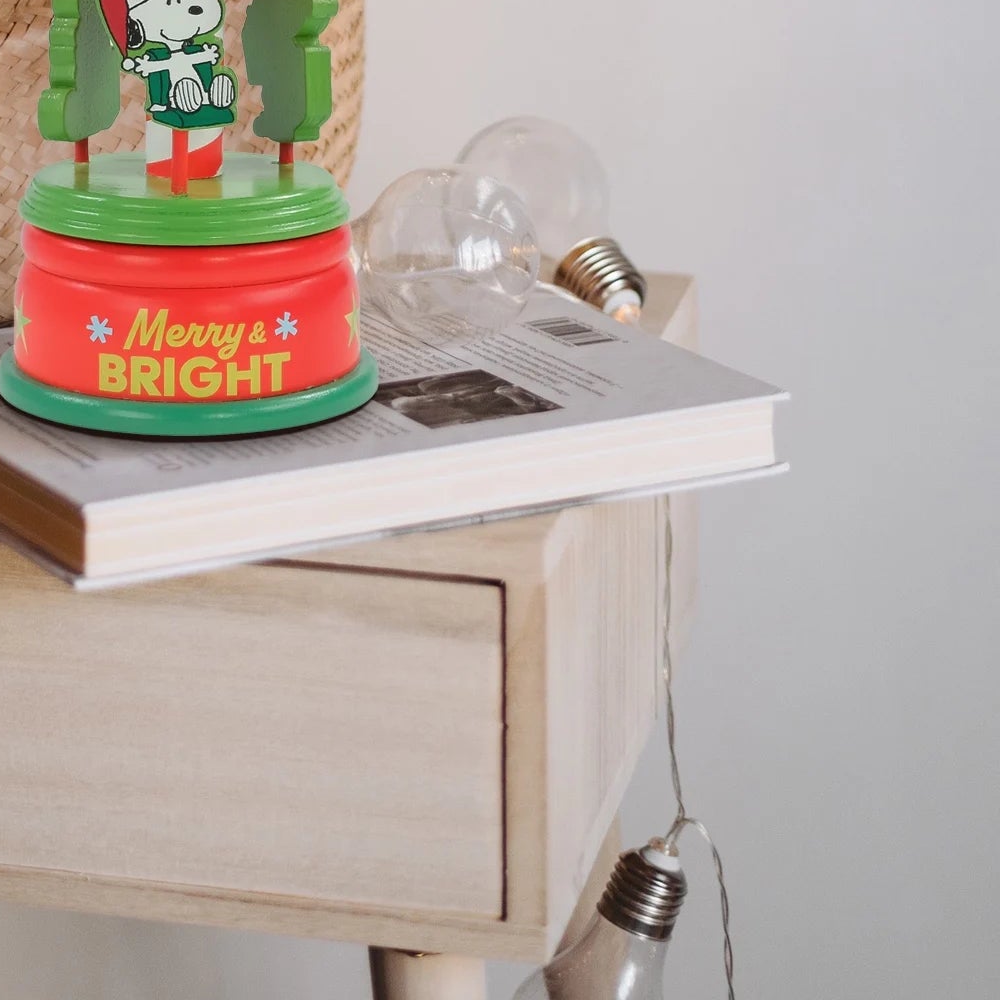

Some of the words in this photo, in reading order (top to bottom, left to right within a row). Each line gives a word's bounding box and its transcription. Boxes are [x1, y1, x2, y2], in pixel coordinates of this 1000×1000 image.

[123, 308, 245, 360] Merry
[248, 320, 267, 344] &
[98, 351, 291, 398] BRIGHT
